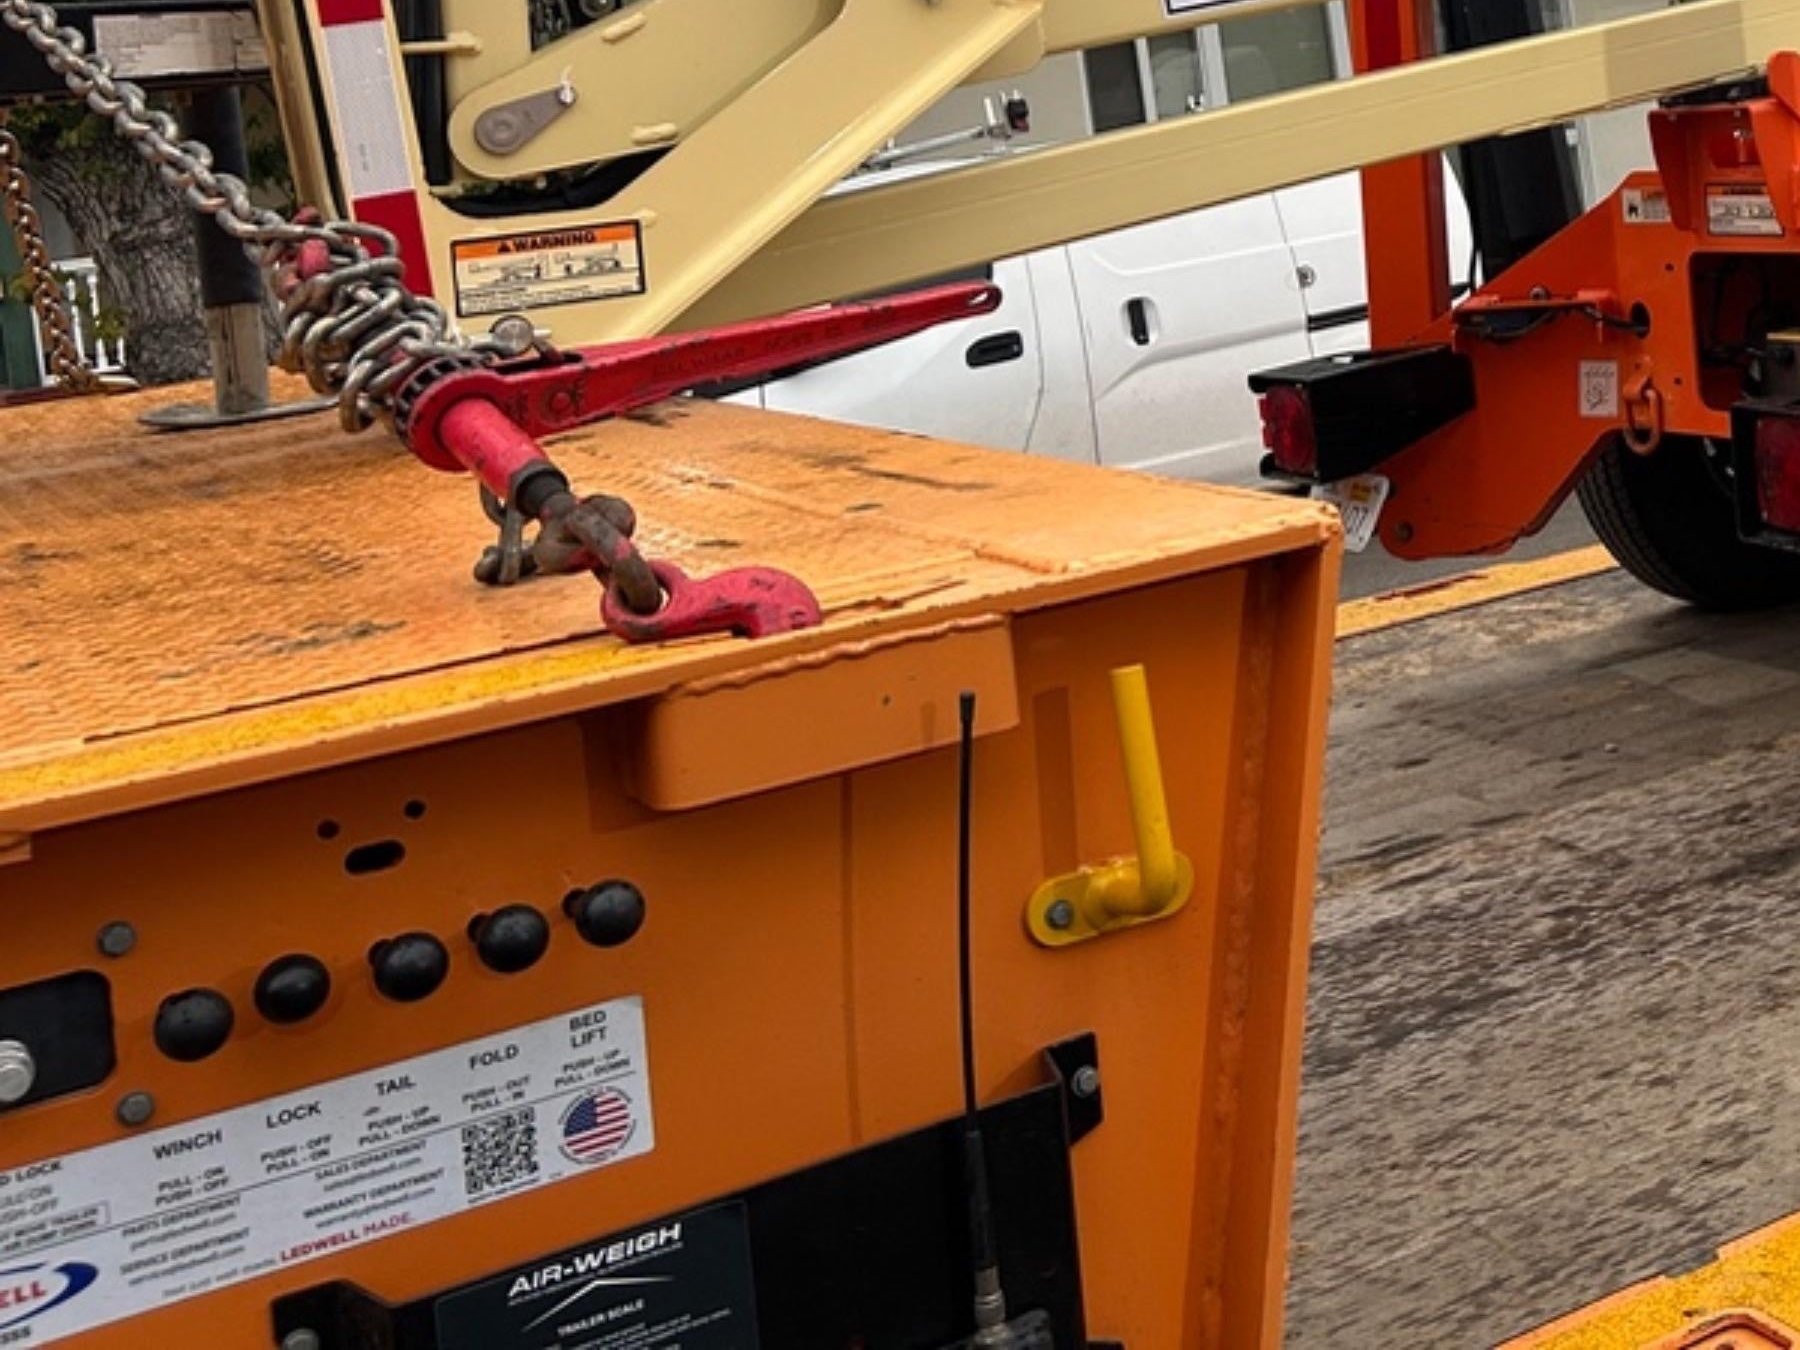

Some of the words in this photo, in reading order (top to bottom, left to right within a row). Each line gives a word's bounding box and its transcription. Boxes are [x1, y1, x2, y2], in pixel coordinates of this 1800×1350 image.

[512, 230, 597, 252] WARNING
[568, 1010, 608, 1032] BED
[570, 1026, 608, 1049] LIFT
[469, 1043, 520, 1071] FOLD
[375, 1073, 418, 1097] TAIL
[265, 1100, 322, 1130] LOCK
[152, 1128, 223, 1160] WINCH
[15, 1160, 62, 1182] LOCK
[279, 1227, 360, 1264] LEDWELL
[506, 1221, 683, 1300] AIR-WEIGH
